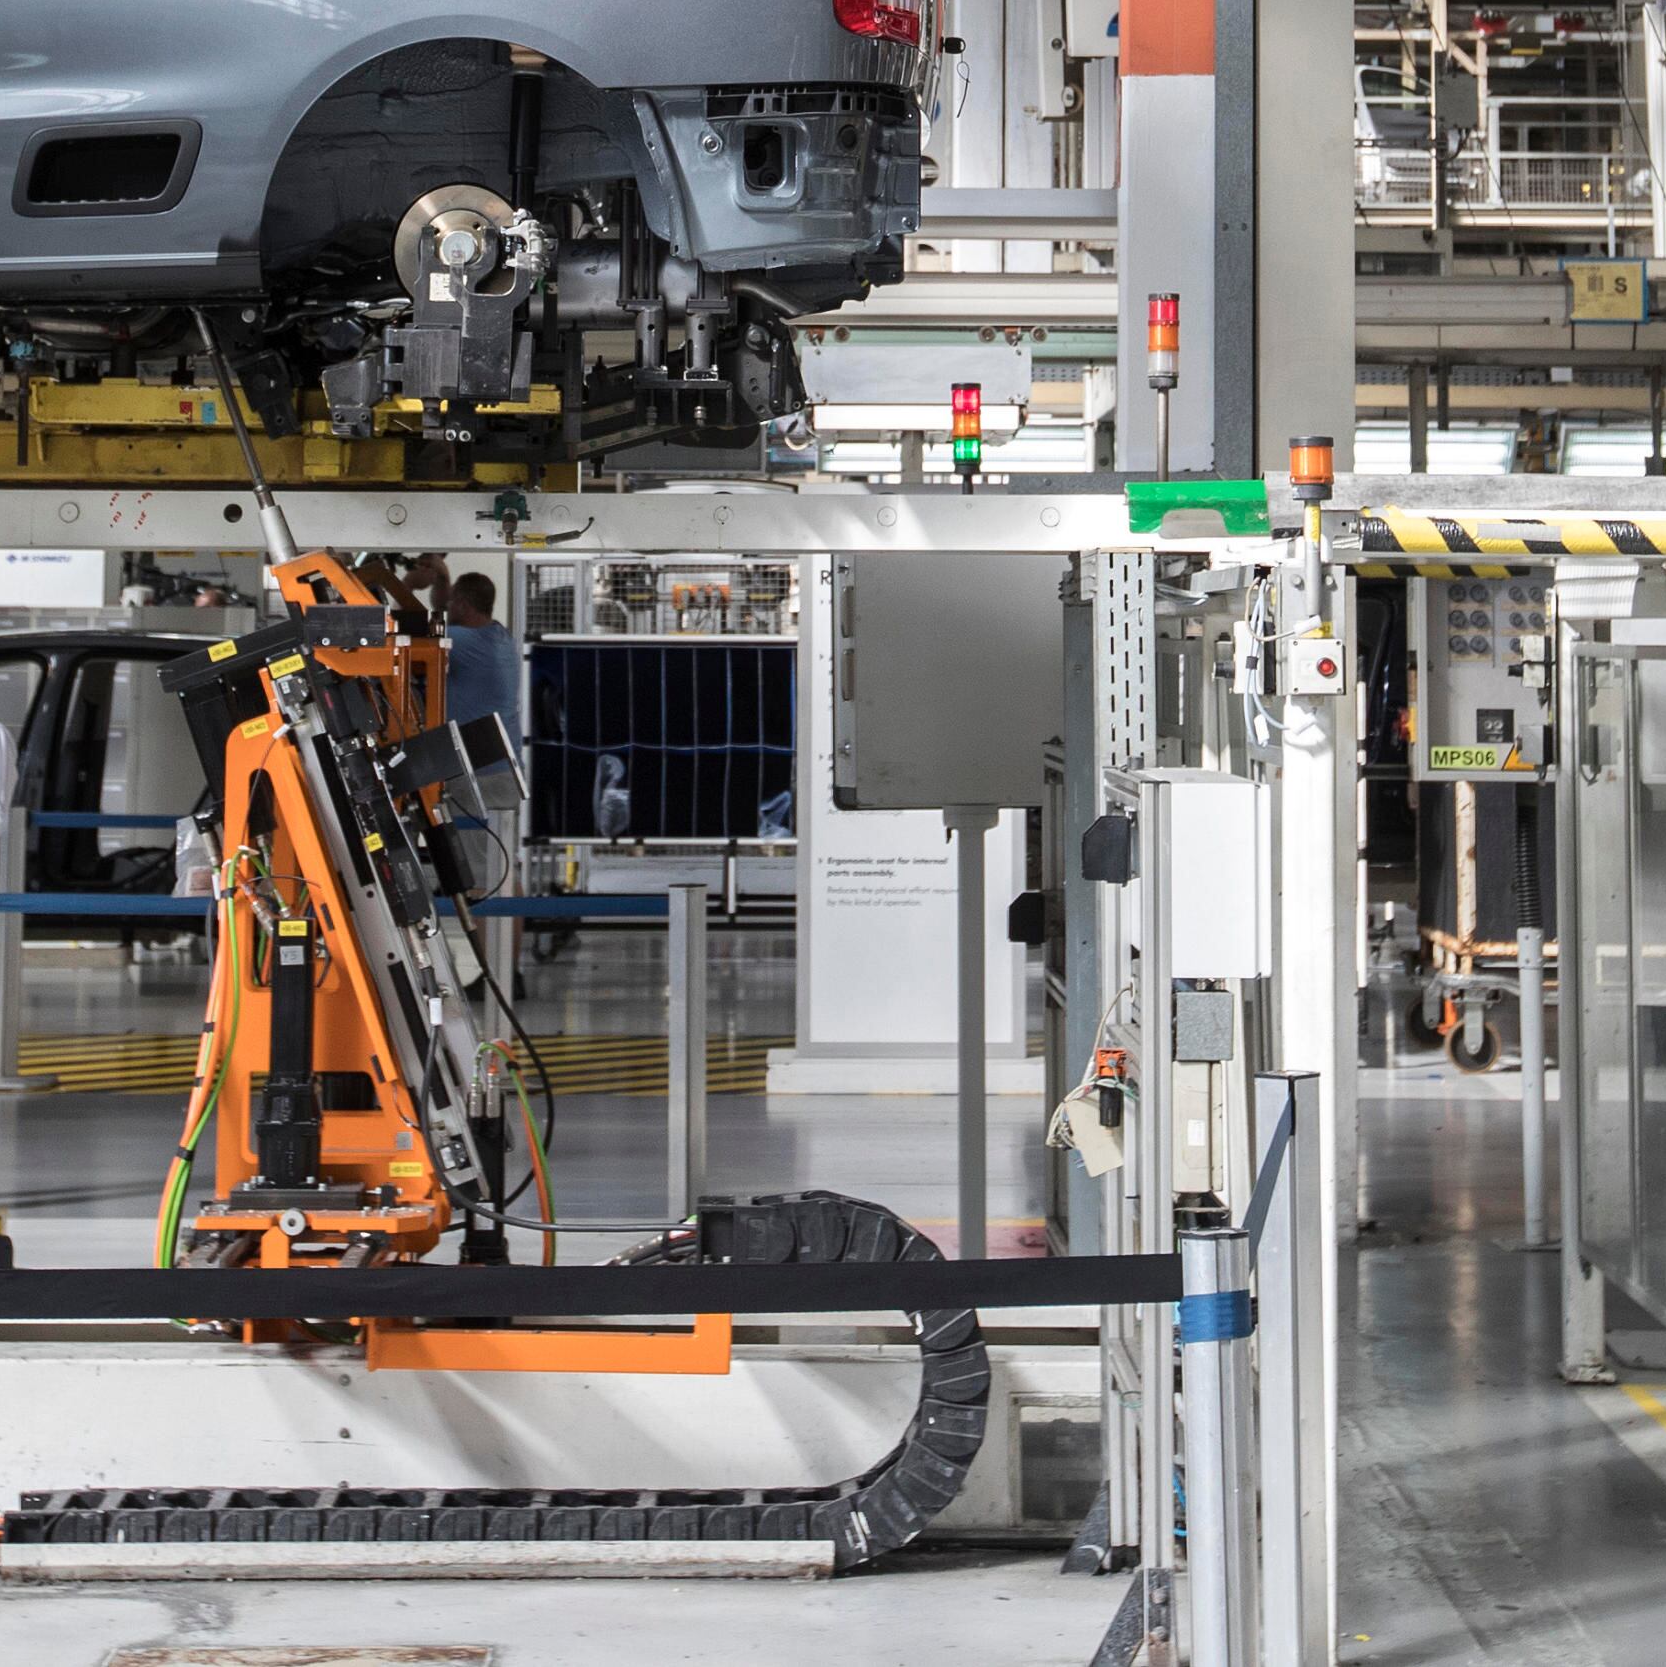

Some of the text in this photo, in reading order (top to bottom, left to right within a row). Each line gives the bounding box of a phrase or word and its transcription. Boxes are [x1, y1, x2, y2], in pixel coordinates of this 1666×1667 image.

[1614, 276, 1628, 295] S
[1434, 750, 1495, 766] MPS06
[827, 856, 948, 866] Ergonomic seat for internal
[827, 869, 897, 878] parts assembly.
[827, 885, 858, 894] Reduces
[861, 885, 873, 894] the
[874, 885, 907, 896] physical
[908, 885, 931, 894] effort
